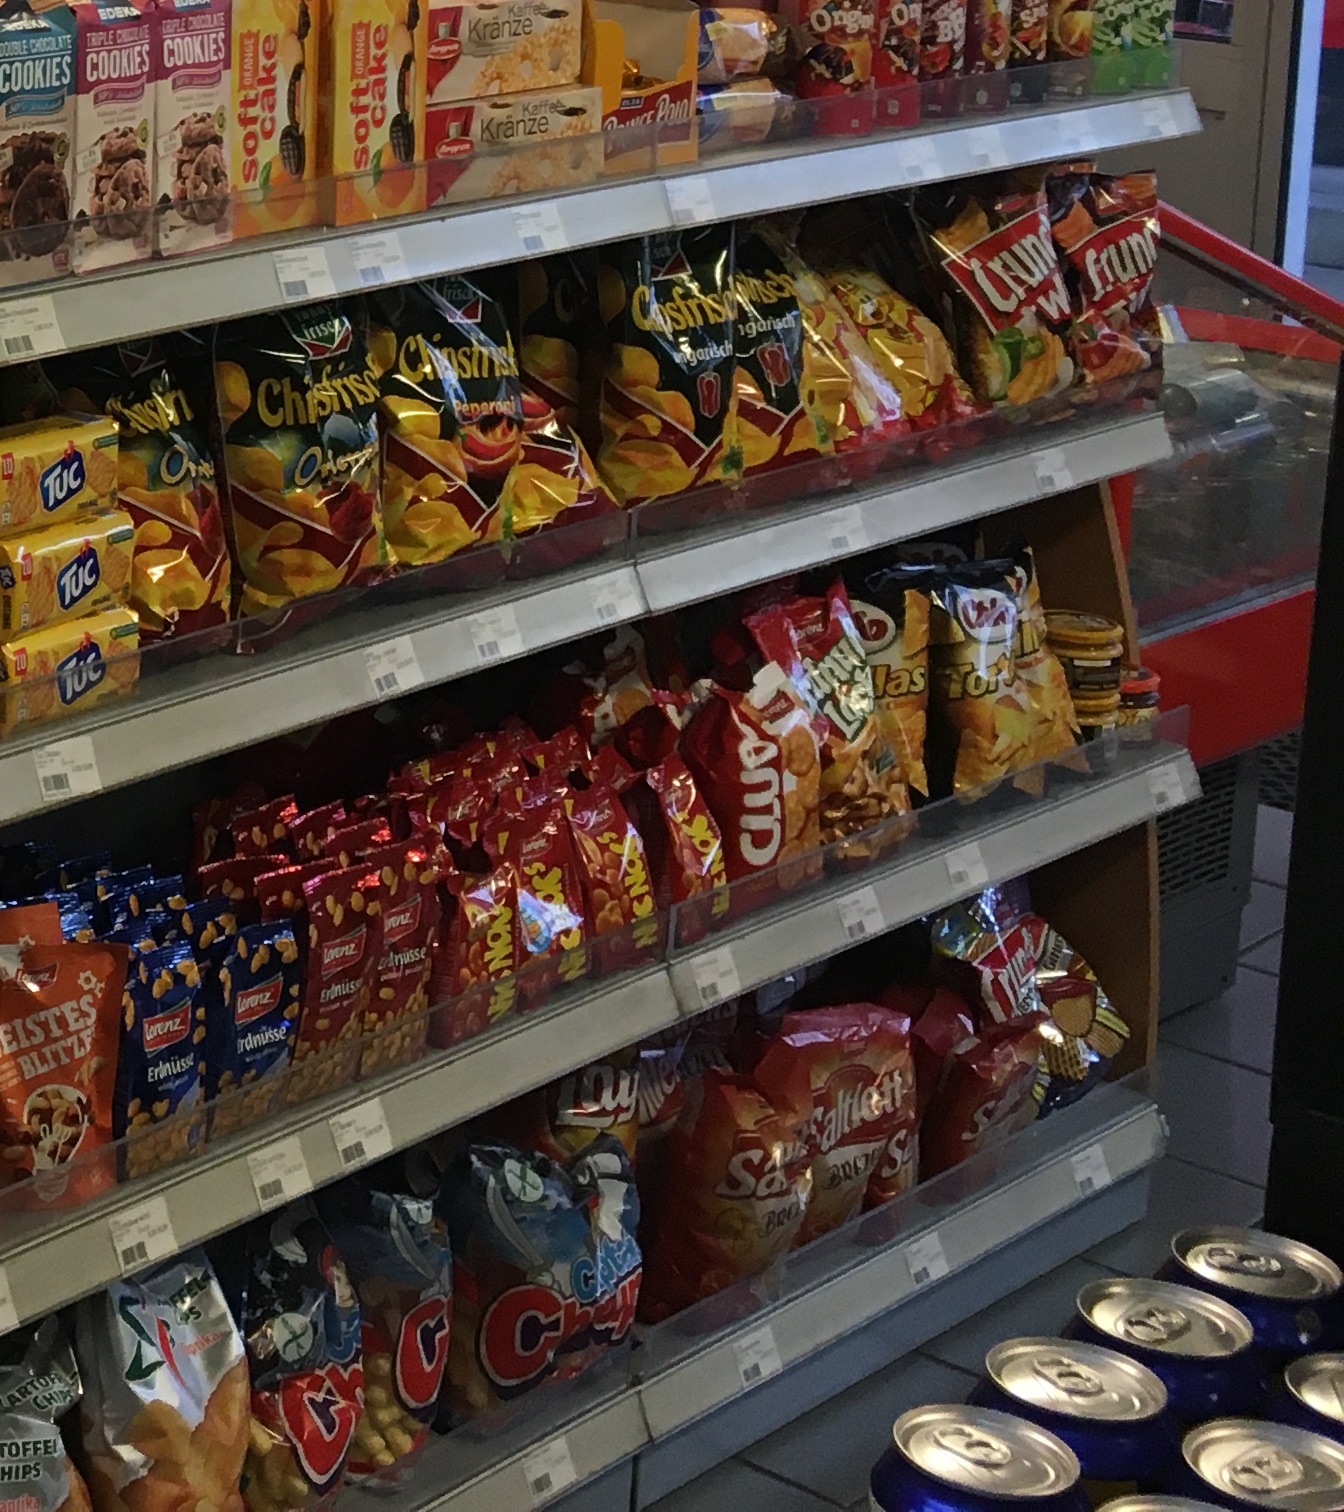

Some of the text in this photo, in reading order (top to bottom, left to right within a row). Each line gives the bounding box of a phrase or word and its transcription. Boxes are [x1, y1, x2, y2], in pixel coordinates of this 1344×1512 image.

[98, 6, 141, 22] EDEKA
[507, 1, 548, 19] Kaffee
[86, 29, 111, 47] TRIPLE
[467, 14, 534, 42] Kränze
[86, 47, 151, 83] COOKIES
[243, 37, 254, 86] ORANGE
[257, 32, 278, 142] cake
[240, 92, 261, 184] soft
[453, 396, 517, 419] Peperoni
[44, 464, 84, 509] TUC
[143, 1016, 185, 1041] Lorenz
[147, 1054, 194, 1083] Erdnüsse
